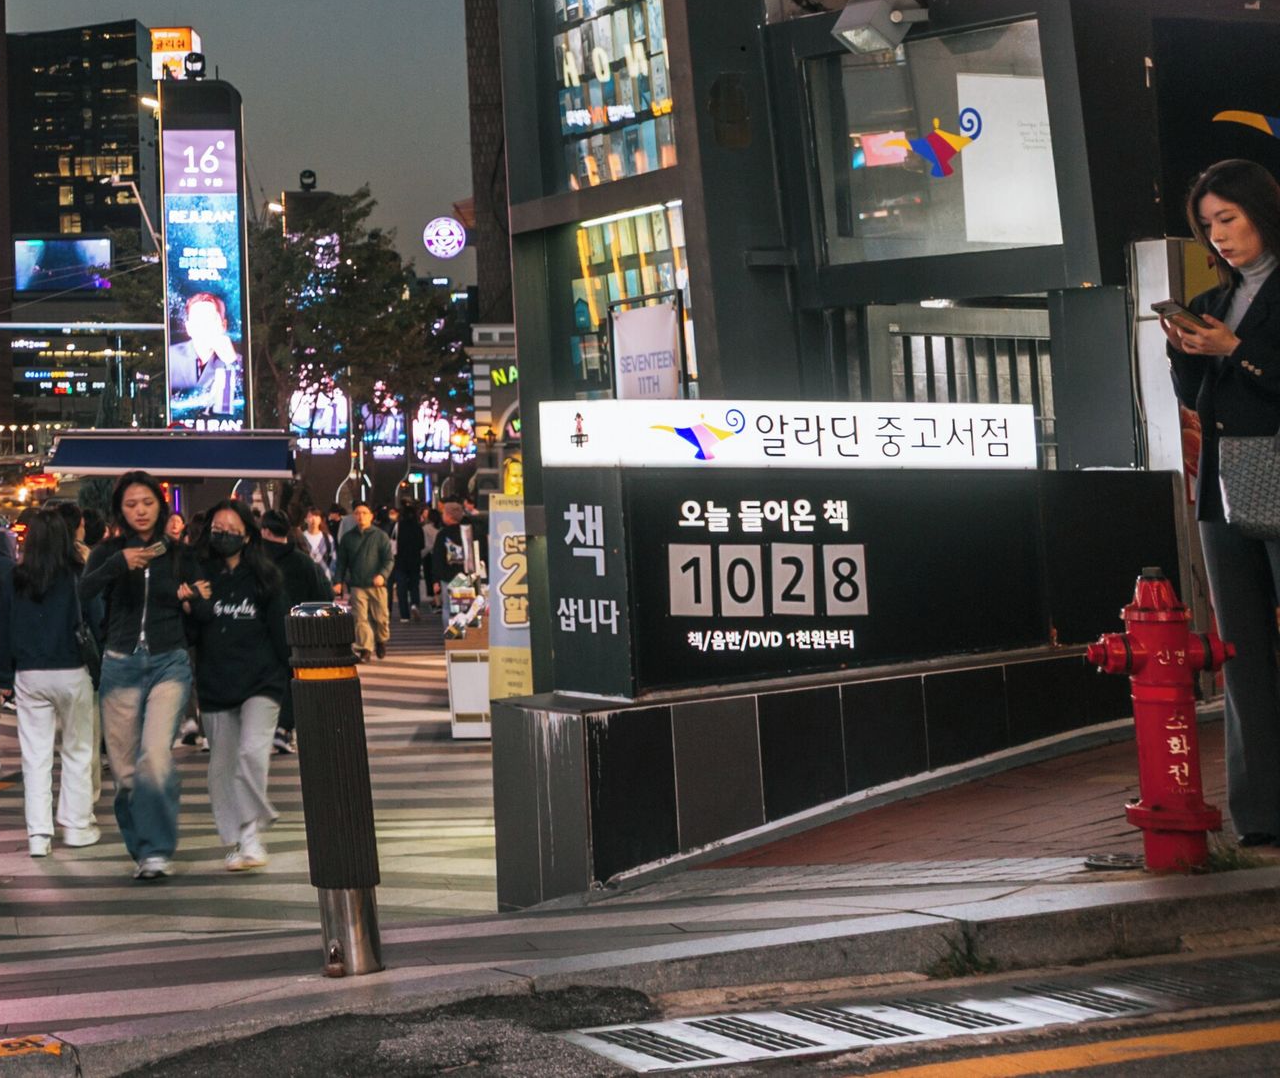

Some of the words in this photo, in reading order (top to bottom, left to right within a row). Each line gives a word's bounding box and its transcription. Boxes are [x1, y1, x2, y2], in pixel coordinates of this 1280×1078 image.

[621, 349, 676, 373] SEVENTEEN
[755, 413, 860, 458] 알라딘
[875, 415, 1010, 458] 중고서점
[678, 500, 731, 532] 오늘
[738, 500, 816, 533] 들어온
[823, 499, 849, 532] 책
[563, 503, 605, 577] 책
[557, 598, 620, 635] 삽니다
[687, 630, 782, 652] 책/음반/DVD
[786, 630, 855, 650] 1천원부터
